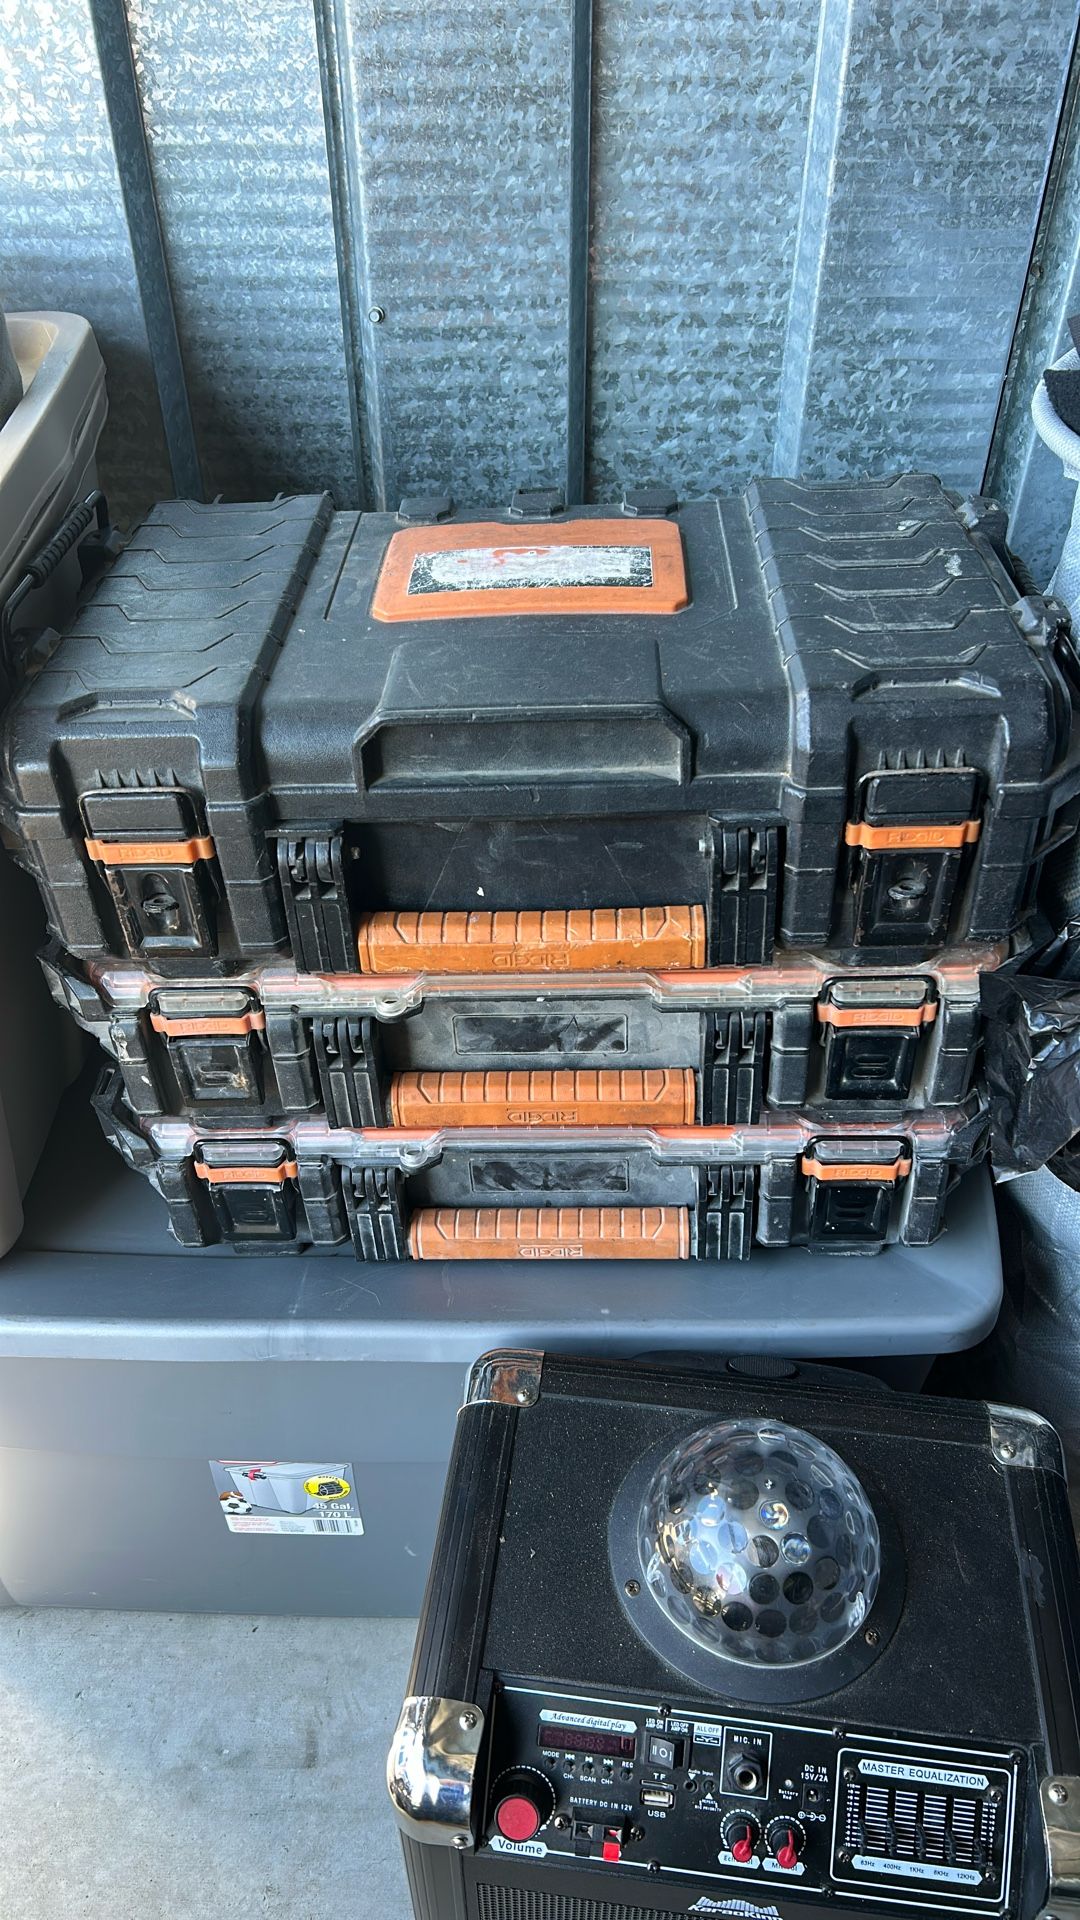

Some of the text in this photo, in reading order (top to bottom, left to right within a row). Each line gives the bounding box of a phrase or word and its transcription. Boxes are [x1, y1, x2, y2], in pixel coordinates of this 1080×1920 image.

[886, 831, 945, 843] RIDGID
[119, 847, 173, 859] RIDGID
[491, 952, 570, 968] RIDGID
[852, 1011, 905, 1022] RIDGID
[506, 1111, 577, 1123] RIDGID
[518, 1247, 583, 1257] RIDGID
[312, 1502, 328, 1510] 45
[550, 1712, 627, 1731] Advanced digital play
[696, 1725, 720, 1734] ALL OFF
[733, 1735, 762, 1746] MIC. IN
[542, 1750, 560, 1758] MODE
[621, 1761, 634, 1769] REC
[804, 1764, 827, 1775] DC IN
[579, 1775, 597, 1783] SCAN
[800, 1772, 829, 1783] 15V/2A
[861, 1762, 985, 1787] MASTER EQUALIZATION
[569, 1796, 598, 1807] BATTERY
[610, 1802, 619, 1810] IN
[620, 1803, 633, 1811] 12V
[647, 1809, 666, 1819] USB
[498, 1839, 543, 1855] Volume
[883, 1863, 901, 1871] 400Hz
[909, 1866, 924, 1874] 1KHz
[957, 1872, 976, 1881] 12KHz
